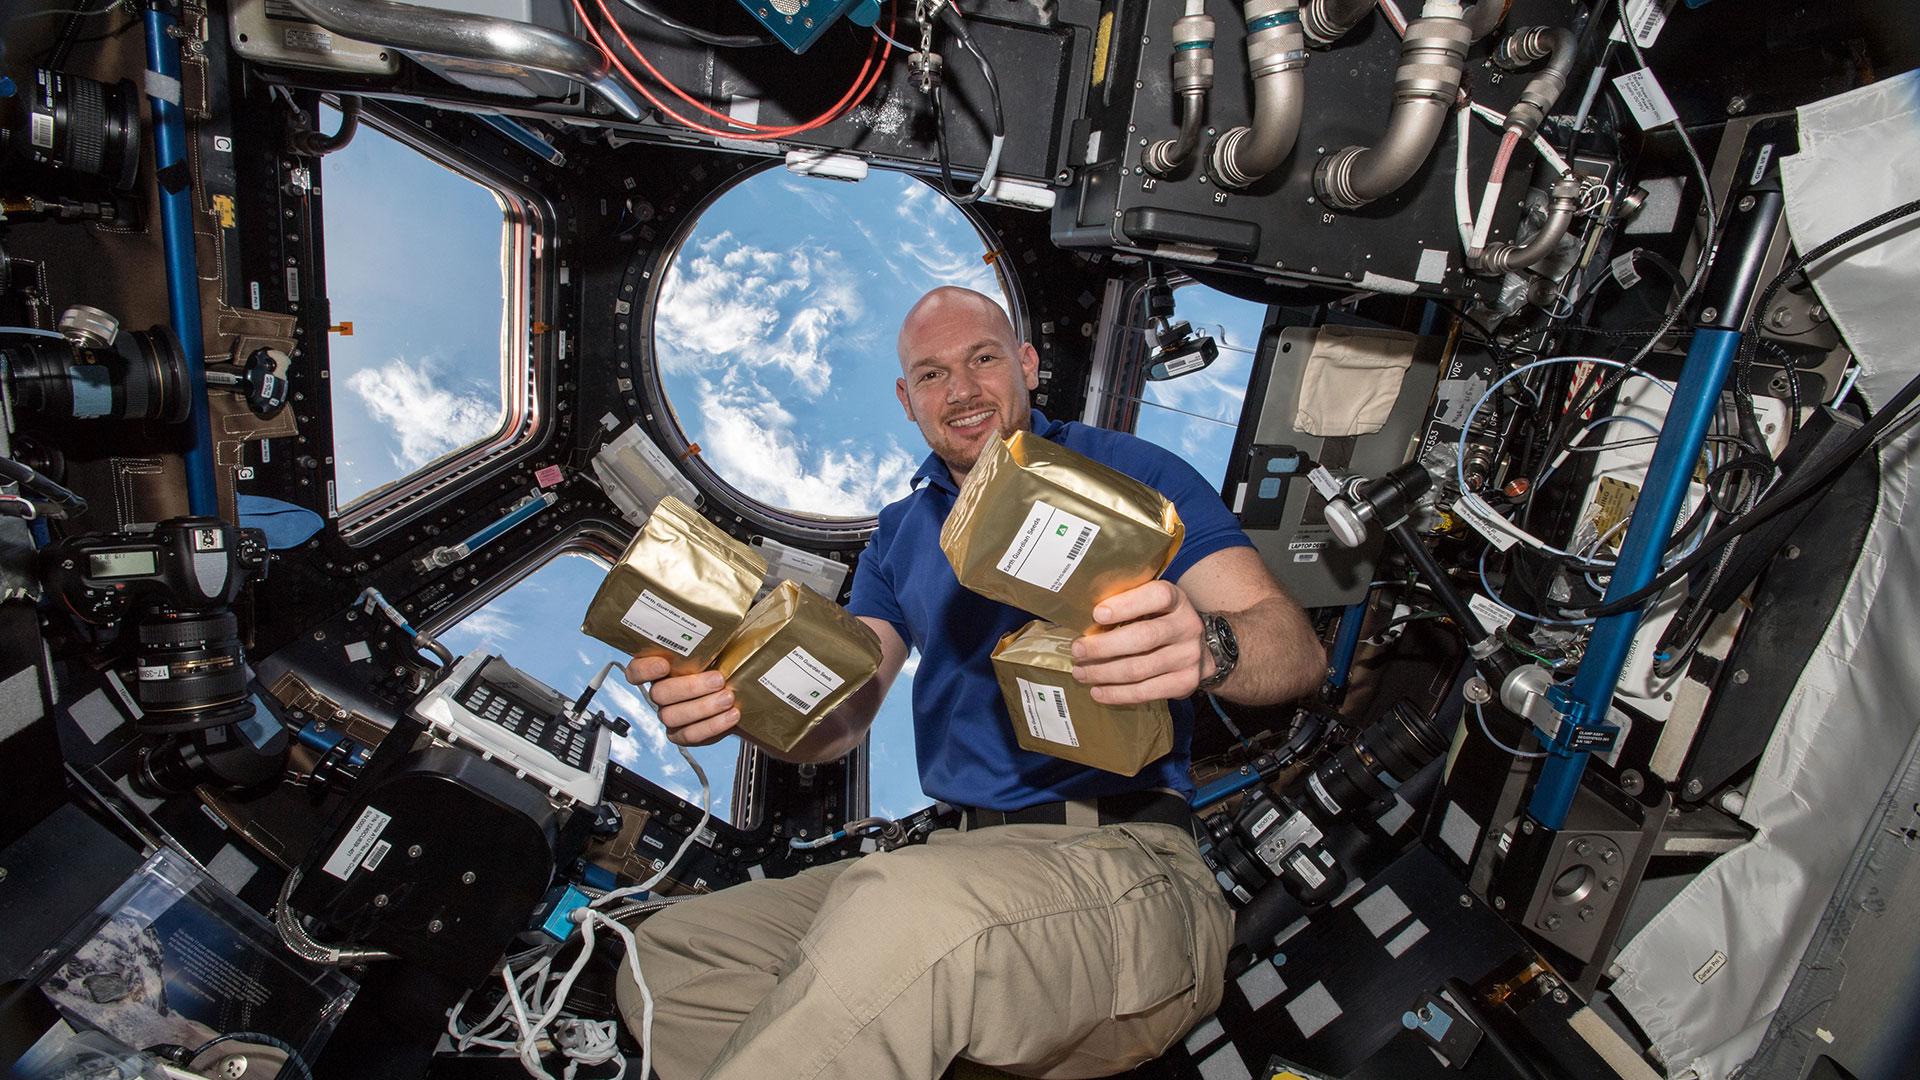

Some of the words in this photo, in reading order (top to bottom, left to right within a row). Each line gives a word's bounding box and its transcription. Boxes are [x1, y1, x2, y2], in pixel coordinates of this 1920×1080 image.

[1489, 72, 1502, 83] J2
[218, 138, 231, 151] C
[1143, 179, 1156, 190] J7
[1215, 192, 1227, 203] J5
[1323, 212, 1335, 223] J3
[1464, 276, 1476, 287] J1
[1451, 360, 1463, 379] VDC
[1003, 557, 1015, 572] Earth
[1011, 534, 1030, 560] Guardian
[1026, 516, 1040, 535] Seeds
[640, 592, 656, 604] Earth
[655, 602, 681, 618] Guardian
[680, 616, 697, 628] Seeds
[791, 649, 804, 660] Earth
[801, 658, 822, 674] Guardian
[819, 671, 832, 682] Seeds
[372, 816, 386, 833] Cupola
[366, 832, 376, 843] ATU
[342, 862, 354, 877] Cover
[652, 859, 663, 871] G
[1698, 965, 1713, 980] Curtain
